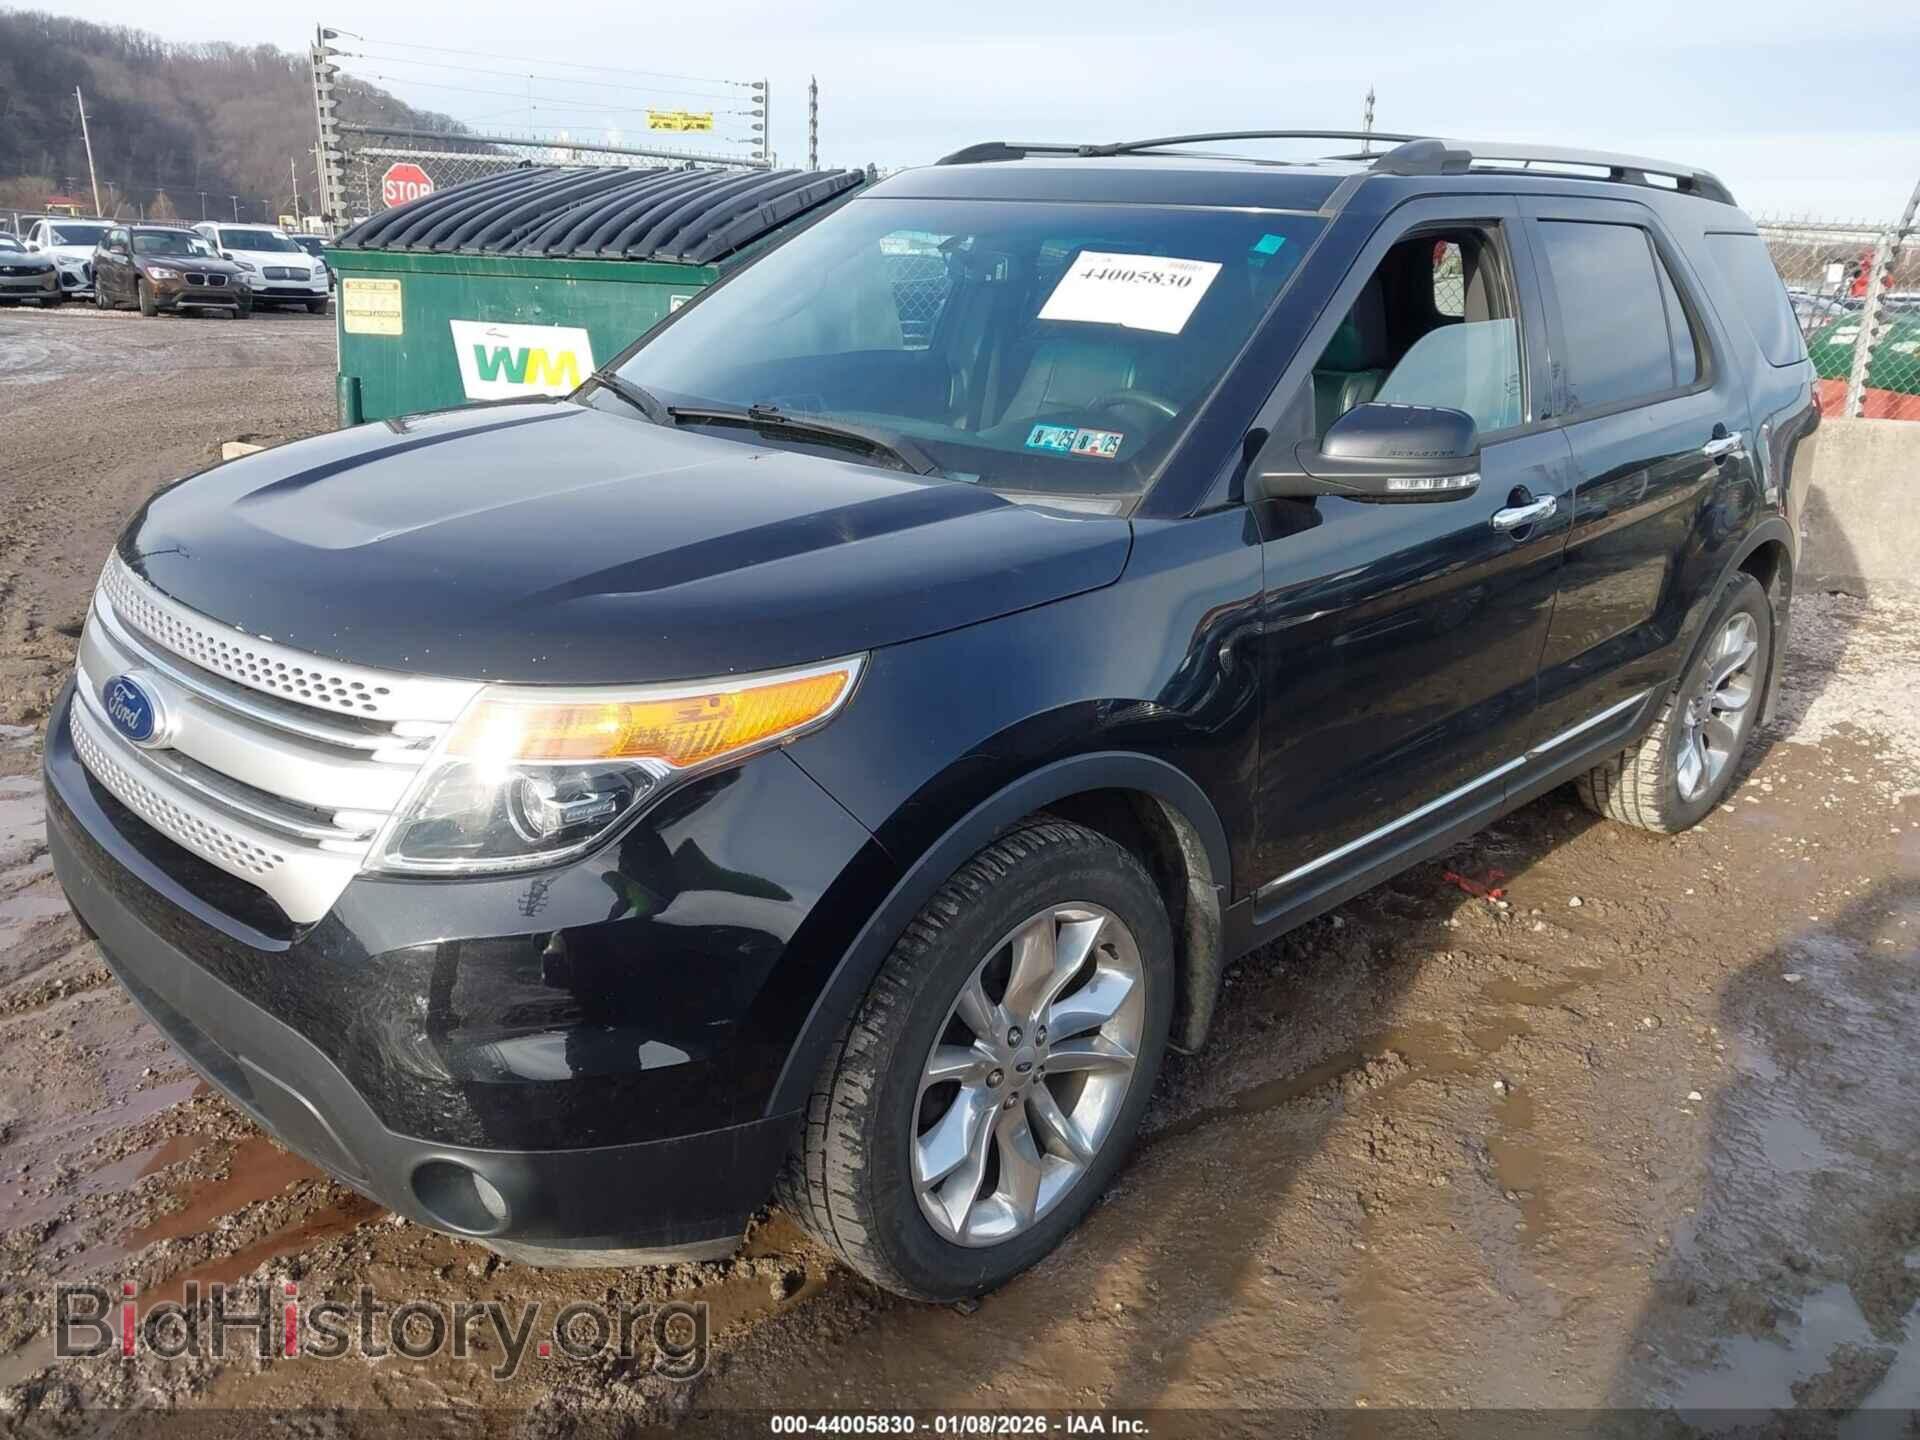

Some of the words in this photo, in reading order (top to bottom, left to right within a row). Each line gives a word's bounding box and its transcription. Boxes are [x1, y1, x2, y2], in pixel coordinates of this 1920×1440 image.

[386, 180, 430, 201] STOP
[1080, 268, 1193, 288] 44005830
[473, 344, 582, 390] WM
[1034, 429, 1044, 445] 8
[1079, 434, 1090, 451] 8
[108, 683, 142, 730] Ford
